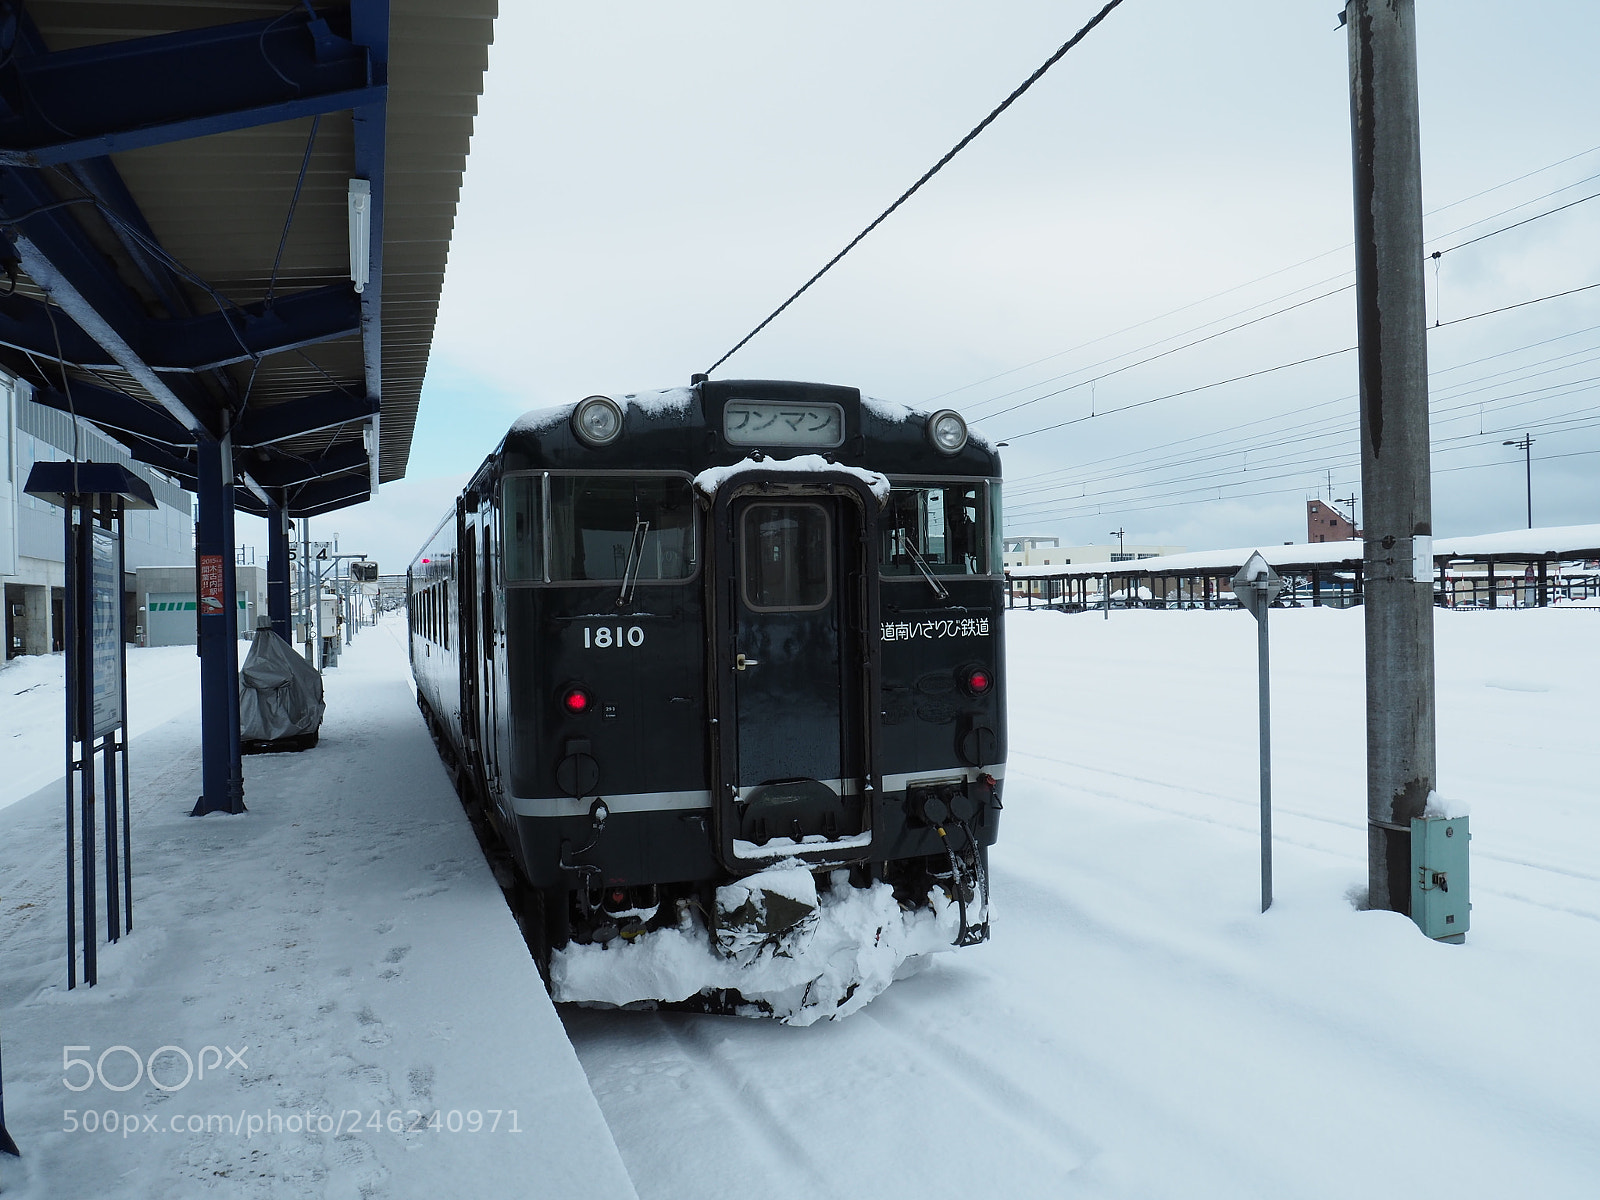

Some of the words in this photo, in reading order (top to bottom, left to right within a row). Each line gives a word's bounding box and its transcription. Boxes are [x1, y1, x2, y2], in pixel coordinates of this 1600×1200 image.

[316, 548, 328, 560] 4
[584, 626, 645, 648] 1810
[880, 617, 990, 642] 道南いさりび鉄道
